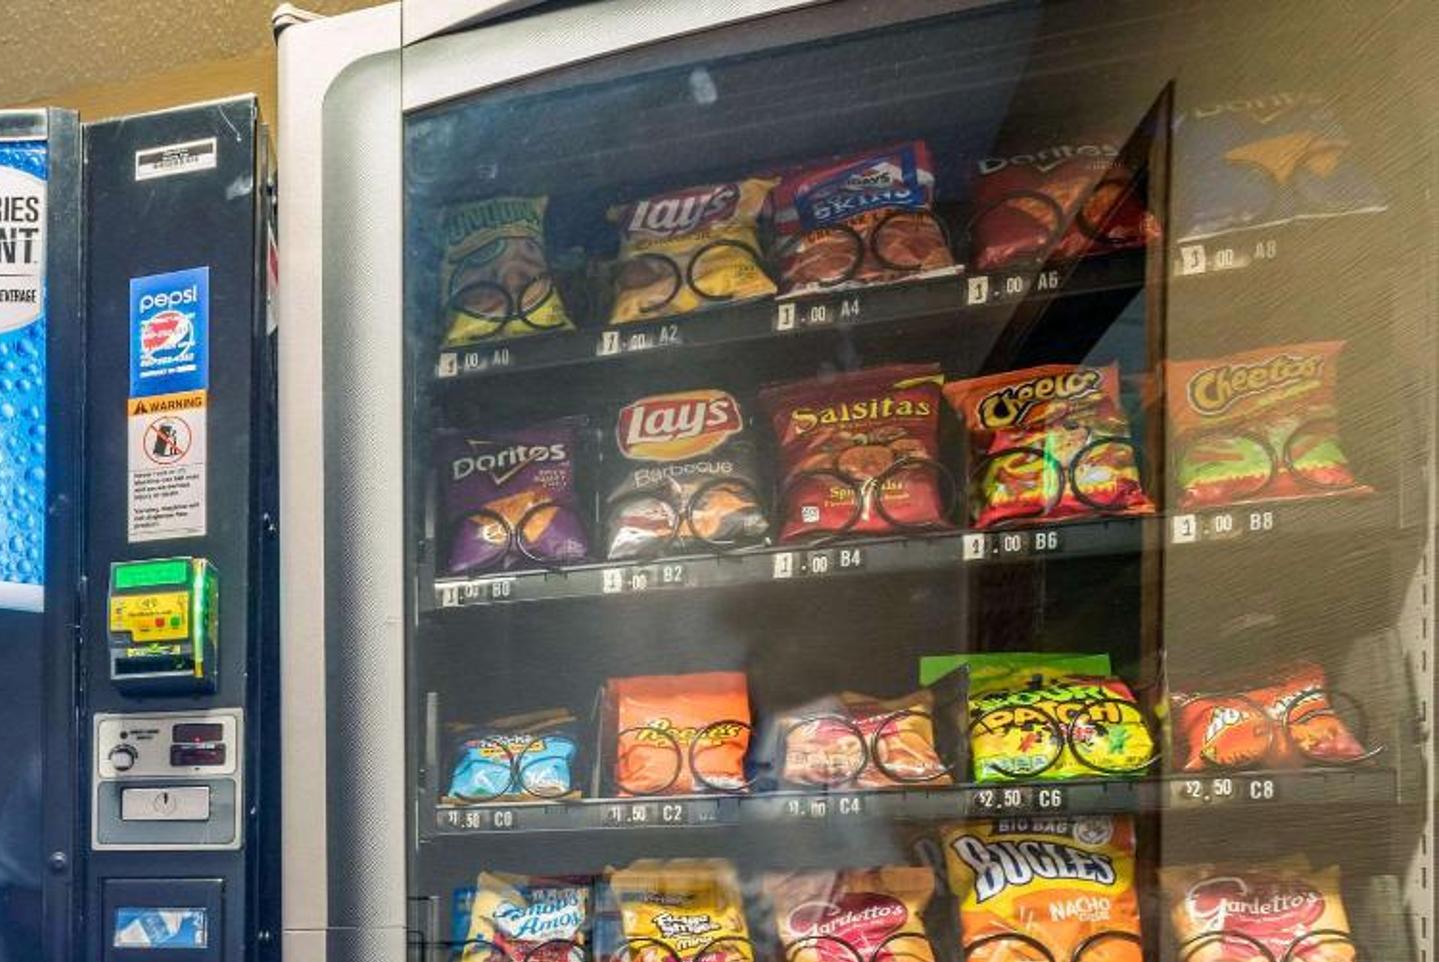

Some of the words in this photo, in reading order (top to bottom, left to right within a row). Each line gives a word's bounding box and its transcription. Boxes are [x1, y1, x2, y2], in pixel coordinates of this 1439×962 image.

[1037, 271, 1059, 292] A6
[139, 284, 198, 313] pepsi
[840, 299, 860, 317] A4
[659, 325, 679, 345] A2
[1187, 354, 1324, 416] Cheetos
[148, 396, 203, 413] WARNING
[792, 396, 931, 434] Salsitas
[452, 442, 567, 482] Doritos
[1249, 511, 1274, 531] B8
[1034, 530, 1059, 551] B6
[839, 548, 861, 568] B4
[663, 565, 683, 584] B2
[1038, 788, 1062, 808] C6
[1249, 779, 1275, 801] C8
[662, 804, 683, 823] C2
[839, 797, 862, 816] C4
[493, 810, 513, 828] C0
[951, 834, 1117, 904] BUGLES
[1048, 896, 1111, 923] NACHO
[1186, 876, 1320, 930] Gardetto's
